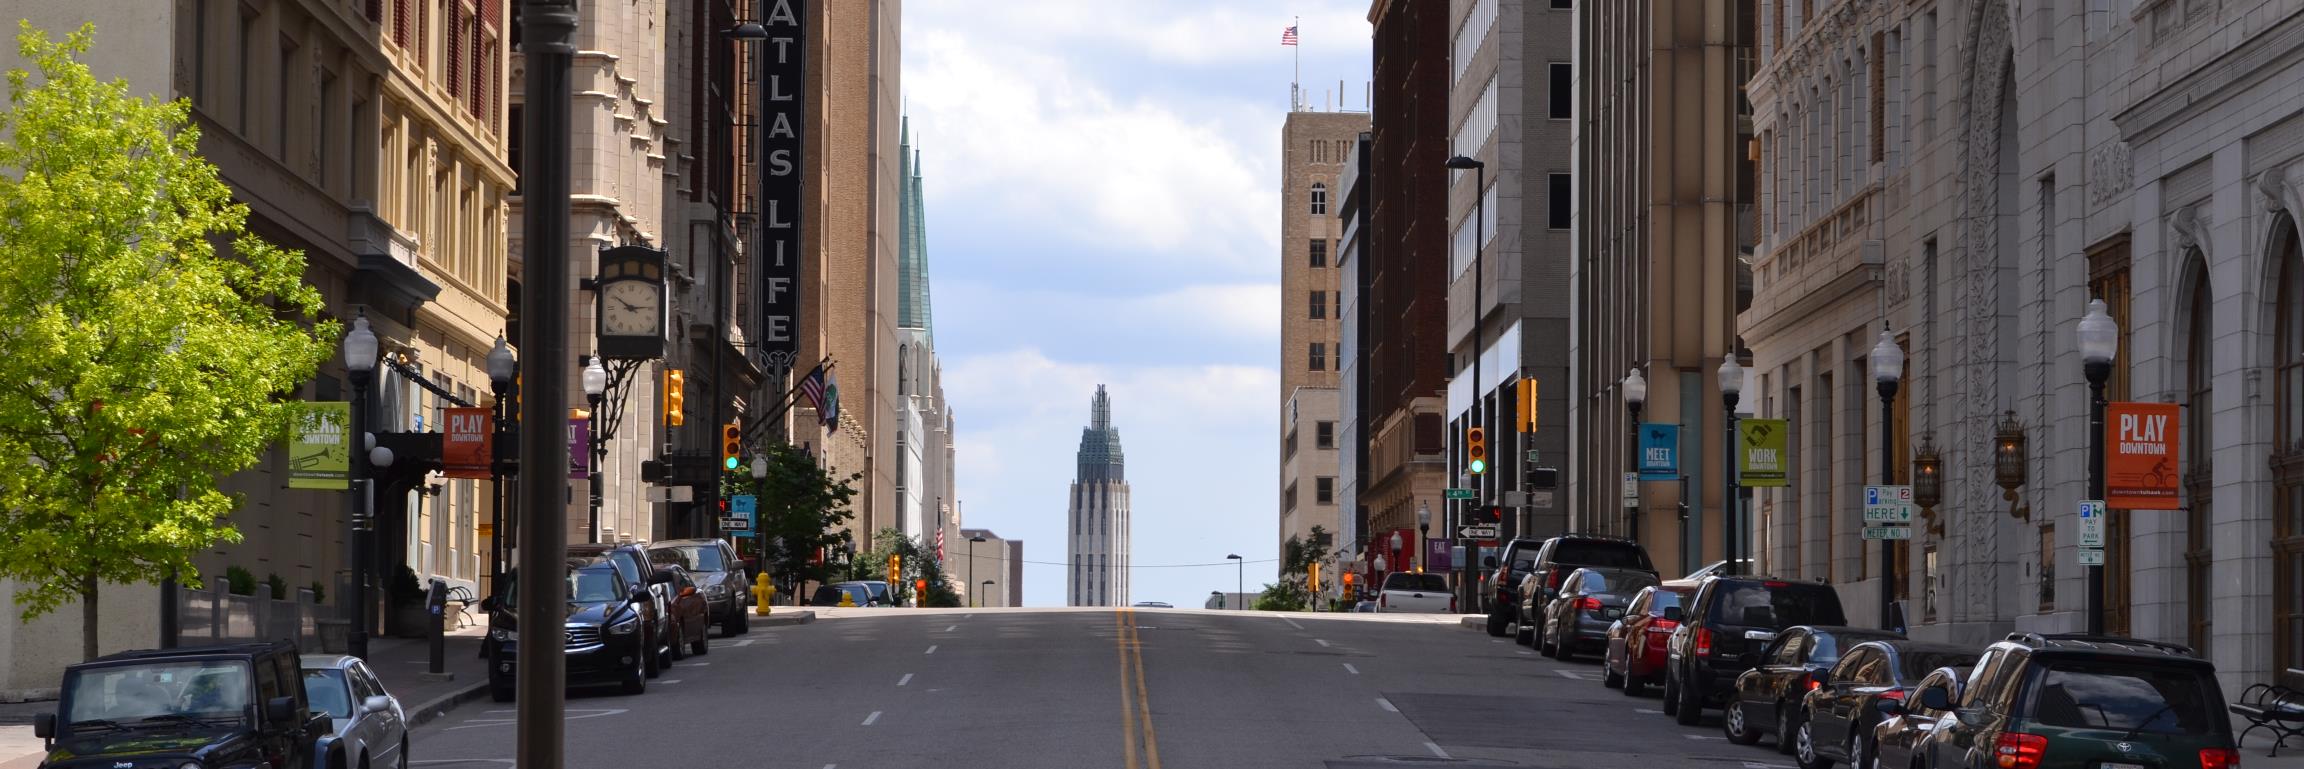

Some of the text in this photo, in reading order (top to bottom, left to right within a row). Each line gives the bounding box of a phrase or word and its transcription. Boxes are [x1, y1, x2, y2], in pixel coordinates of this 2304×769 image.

[766, 0, 798, 342] ATLAS LIFE
[451, 415, 484, 433] PLAY
[2120, 414, 2167, 442] PLAY
[451, 433, 484, 442] DOWNTOWN
[1646, 448, 1670, 461] MEET
[2120, 442, 2166, 455] DOWNTOWN
[1749, 448, 1777, 463] WORK
[1901, 489, 1910, 499] 2
[1866, 508, 1895, 519] HERE
[1867, 528, 1887, 537] METER
[1434, 542, 1446, 551] EAT
